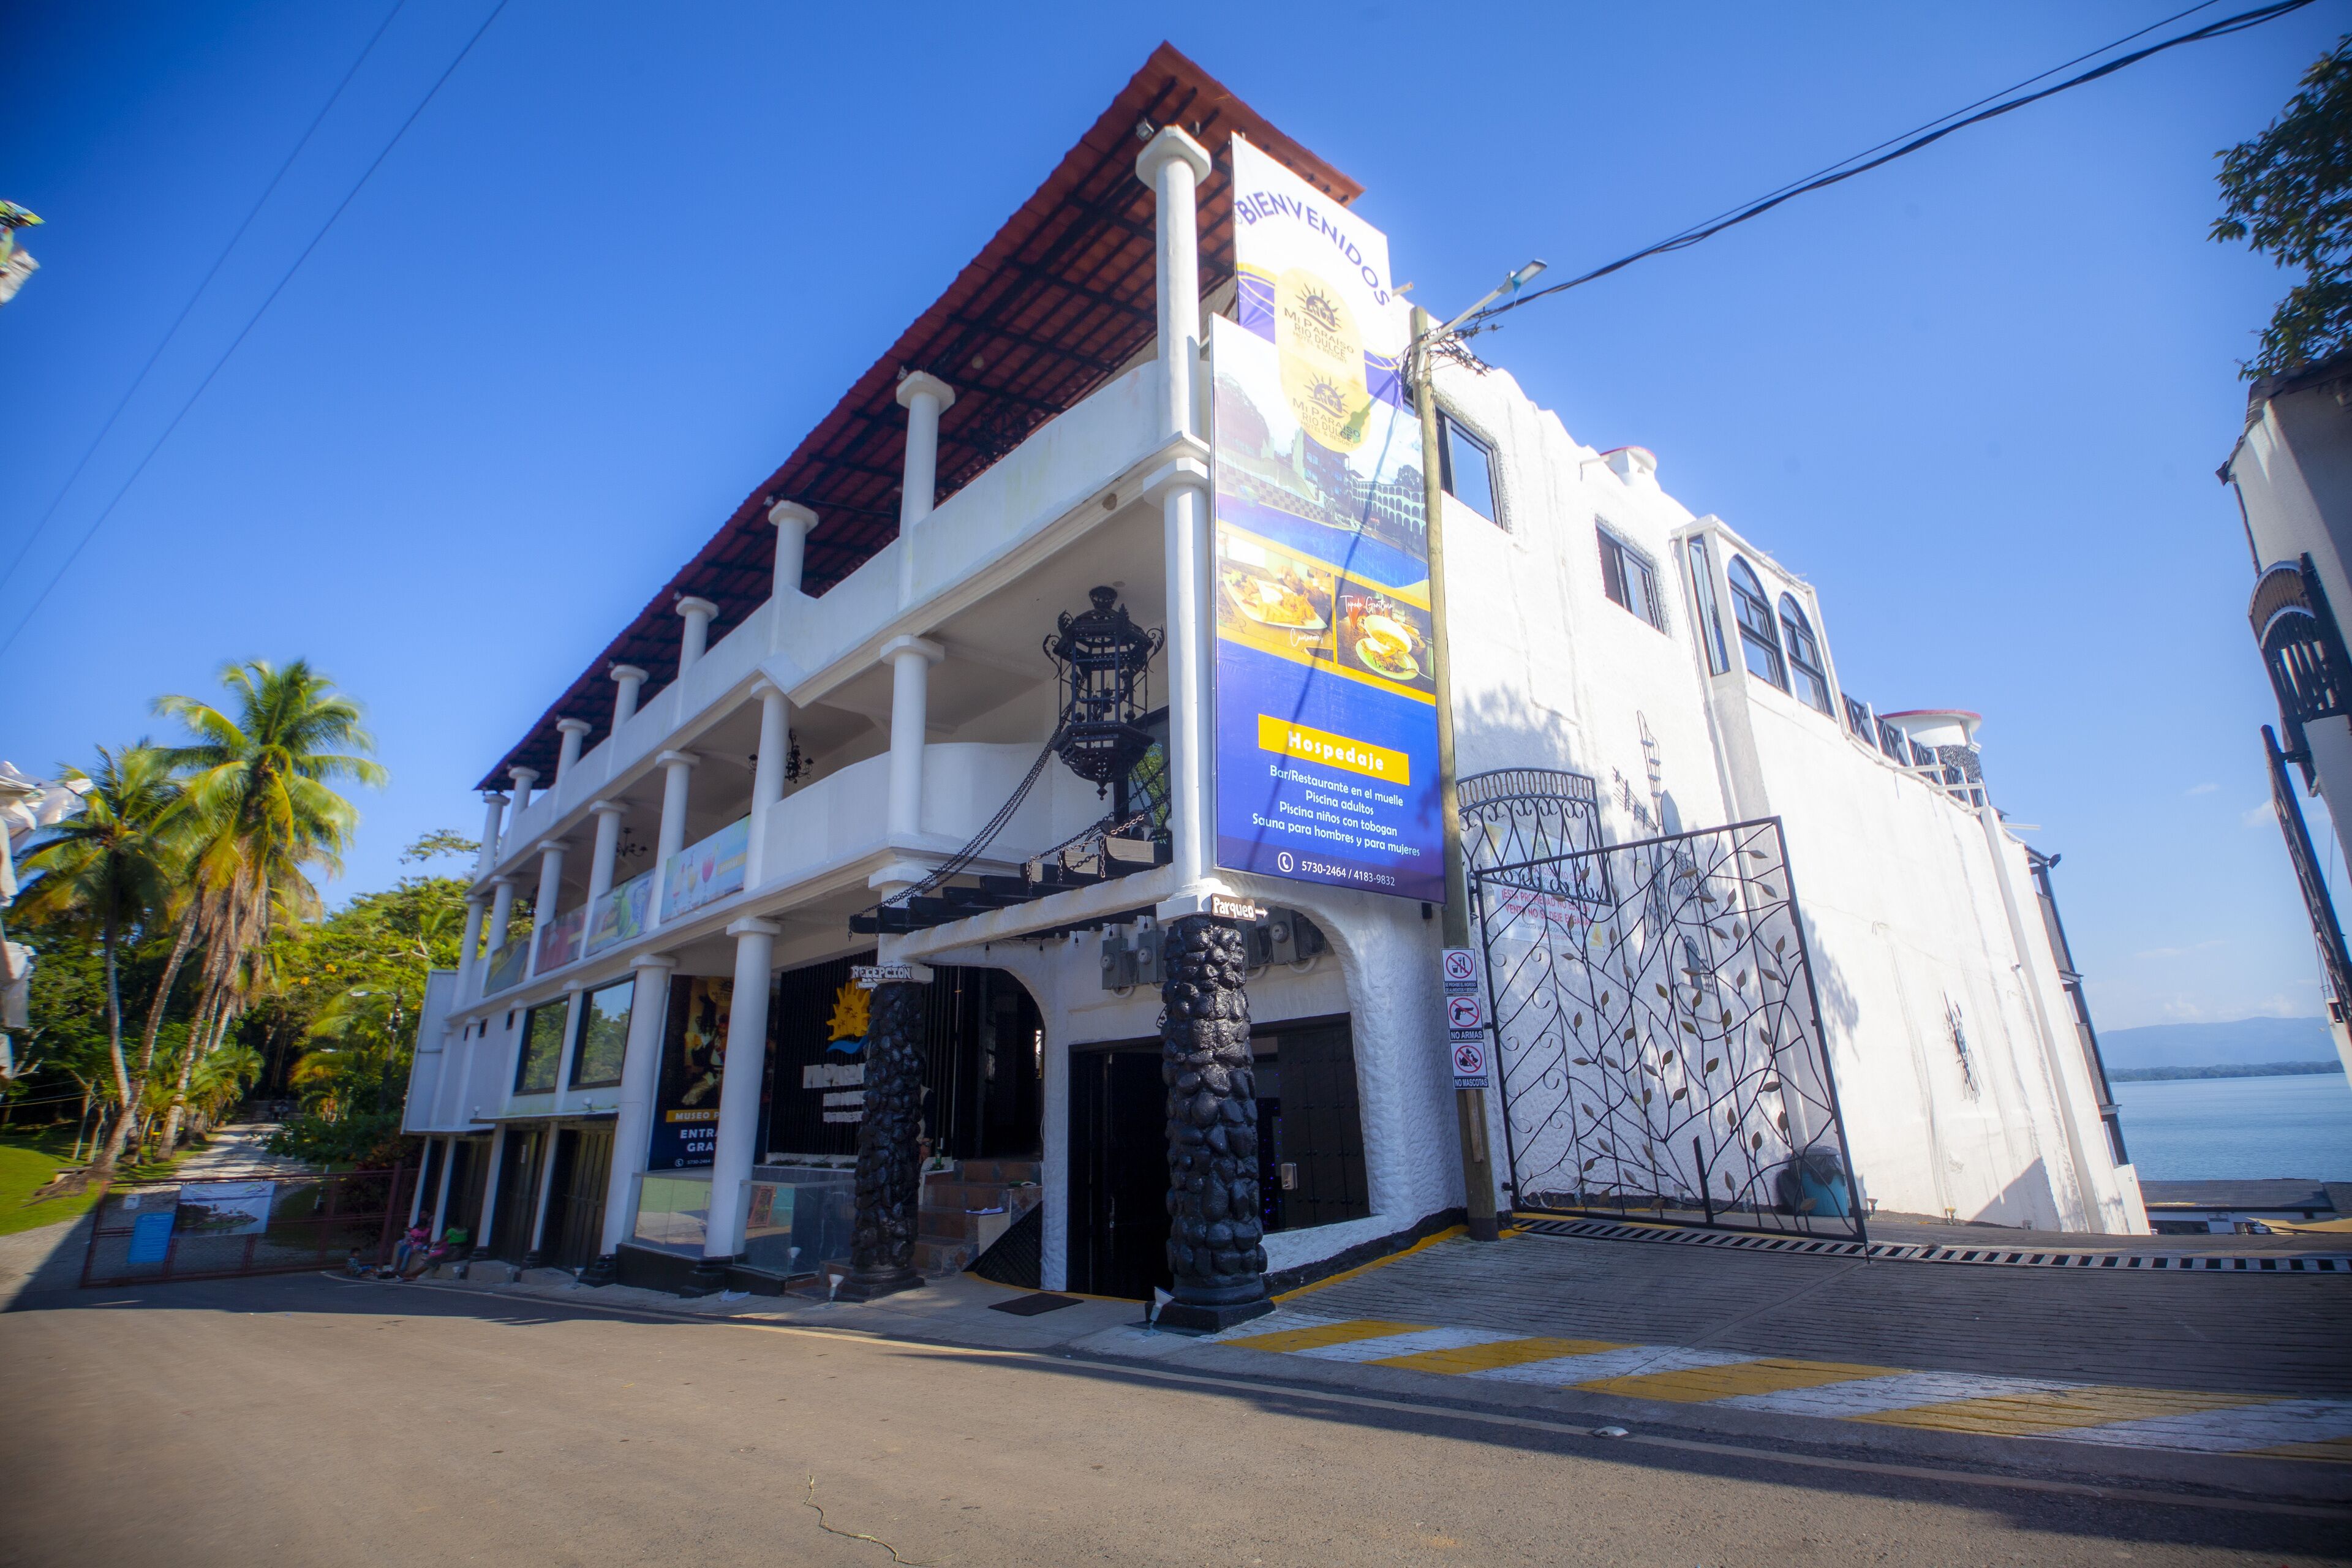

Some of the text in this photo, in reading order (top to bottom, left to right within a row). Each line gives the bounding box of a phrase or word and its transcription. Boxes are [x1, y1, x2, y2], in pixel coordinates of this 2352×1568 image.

[1234, 191, 1390, 306] BIENVENIDOS
[1294, 323, 1346, 360] RIO DULCE
[1302, 412, 1352, 443] RIO DULCE
[1287, 731, 1384, 771] Hospedaje
[1270, 764, 1404, 807] Bar/Restaurante en el muelle
[1306, 790, 1374, 815] Piscina adultos
[1280, 801, 1398, 837] Piscina niños con tobogan
[1252, 813, 1420, 857] Sauna para hombres y para mujeres
[1302, 861, 1395, 887] 5730-2464 / 4183-9832
[1213, 896, 1254, 919] Parqueo
[1528, 908, 1539, 918] NO
[1461, 1031, 1482, 1039] ARMAS
[1463, 1078, 1488, 1087] MASCOTAS
[676, 1112, 710, 1120] MUSEO
